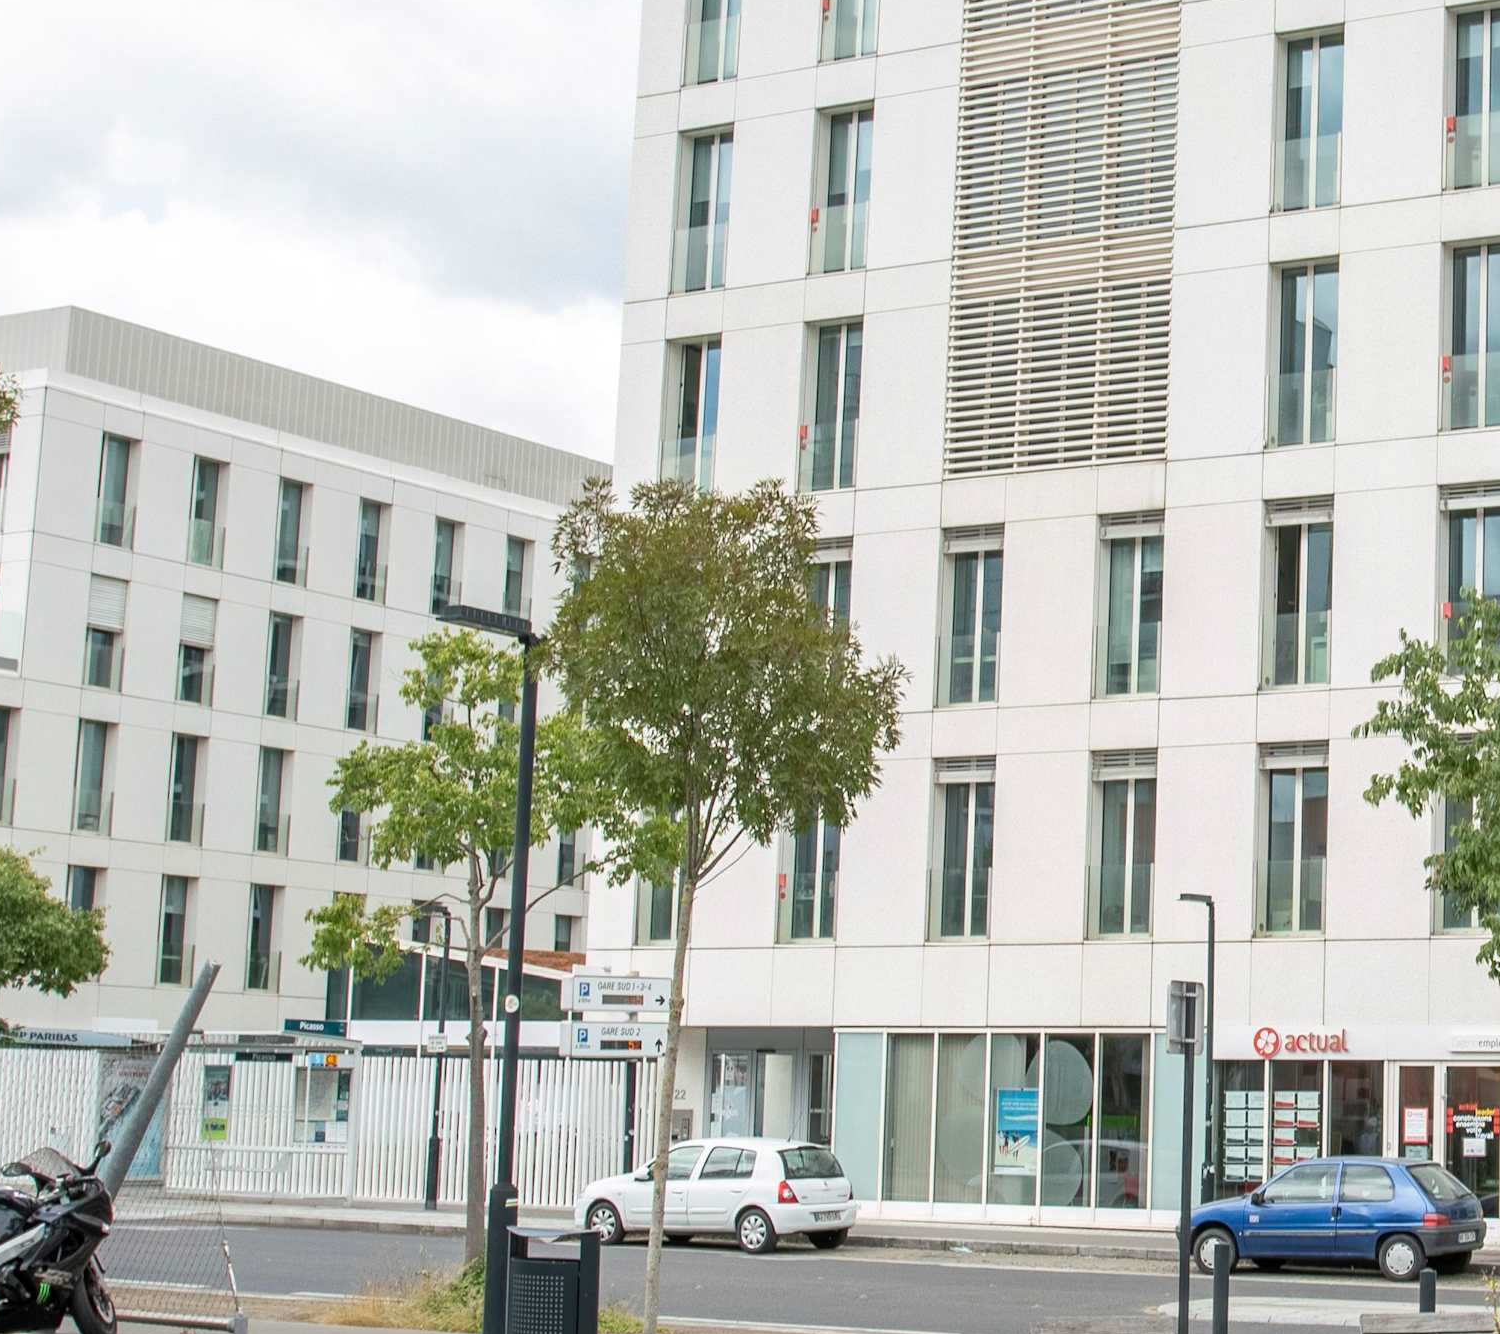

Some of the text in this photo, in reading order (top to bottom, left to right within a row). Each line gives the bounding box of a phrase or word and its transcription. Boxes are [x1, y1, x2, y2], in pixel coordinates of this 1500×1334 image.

[597, 981, 615, 991] GARE
[617, 982, 631, 991] SUD
[299, 1021, 325, 1031] Picasso
[29, 1031, 78, 1043] PARIBAS
[601, 1027, 619, 1036] GARE
[620, 1027, 635, 1037] SUD
[1284, 1028, 1349, 1054] actual
[252, 1054, 277, 1062] Picasso
[674, 1089, 687, 1100] 22
